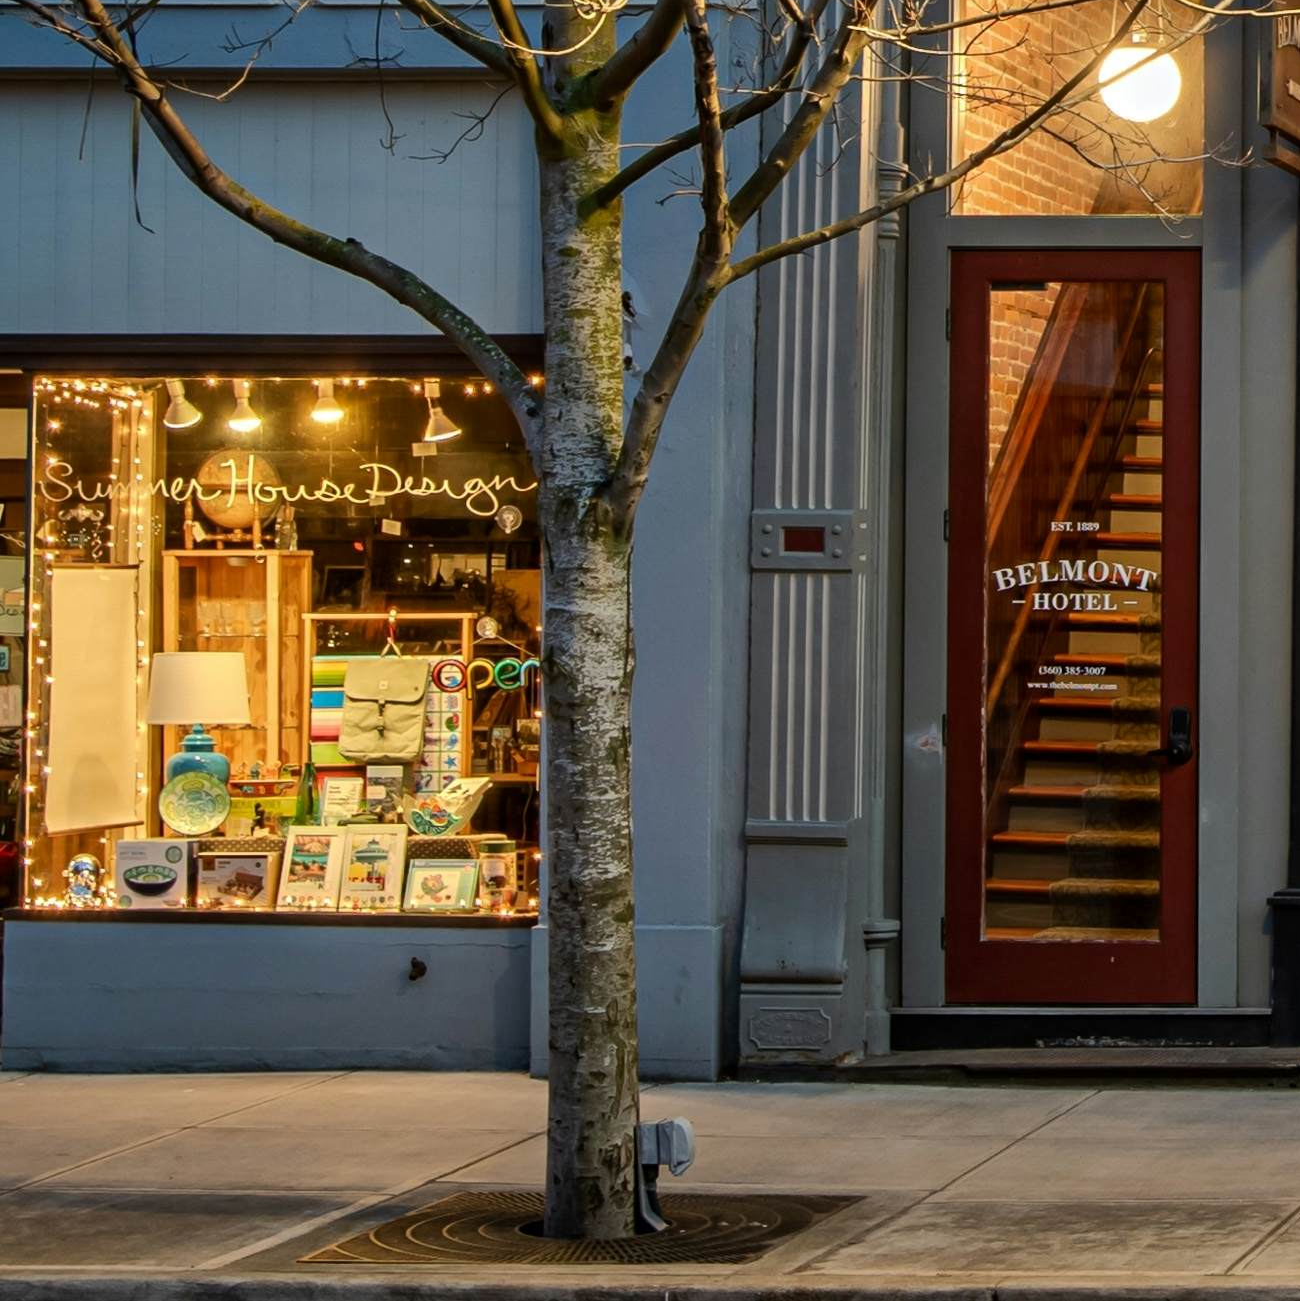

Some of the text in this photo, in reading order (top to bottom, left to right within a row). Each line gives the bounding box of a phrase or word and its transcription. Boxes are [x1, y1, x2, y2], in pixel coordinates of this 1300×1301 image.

[38, 454, 539, 517] Summer House Design
[1050, 521, 1100, 532] EST. 1889
[992, 559, 1158, 592] BELMONT
[1031, 592, 1118, 611] HOTEL
[1038, 666, 1107, 676] (360) 385-3007
